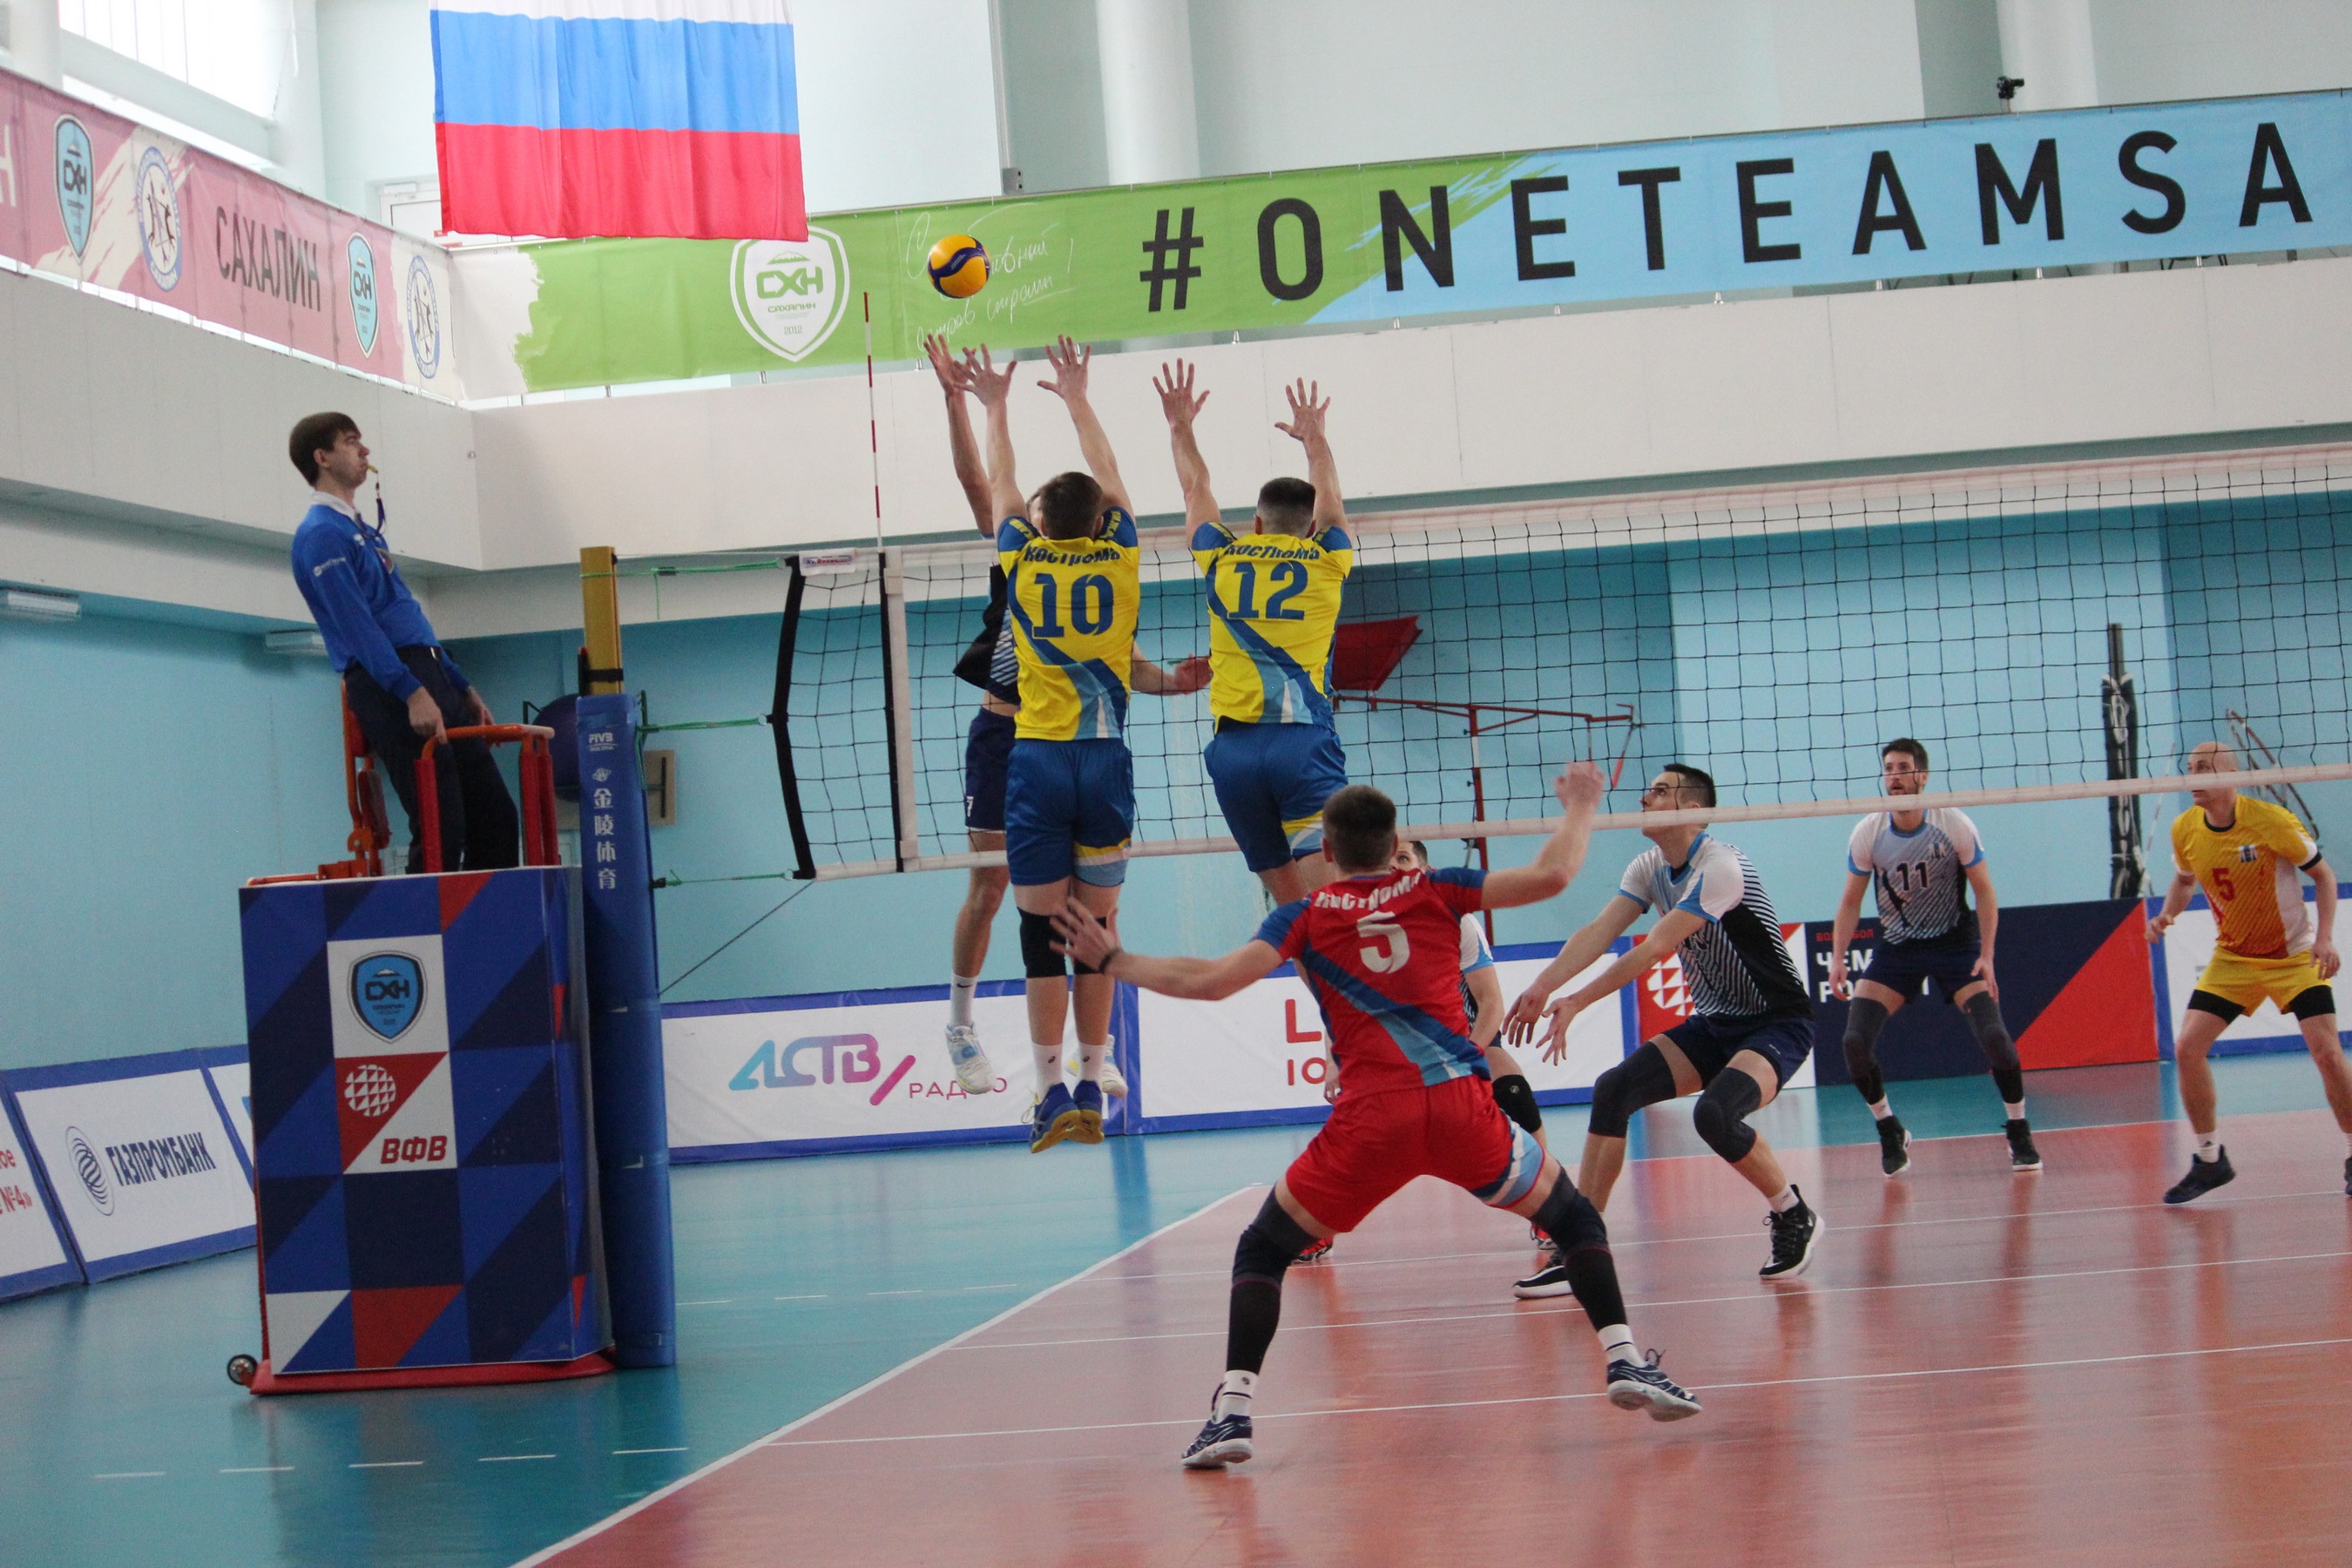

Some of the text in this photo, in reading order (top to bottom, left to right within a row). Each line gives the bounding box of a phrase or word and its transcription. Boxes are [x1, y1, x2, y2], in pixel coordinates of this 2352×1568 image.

[215, 205, 321, 312] САХАЛИН
[767, 302, 816, 314] САХАЛИН
[1032, 573, 1113, 639] 10
[1227, 560, 1308, 621] 12
[588, 732, 614, 744] FIVB
[593, 787, 617, 889] 金陵体育
[1896, 862, 1929, 891] 11
[2211, 868, 2235, 902] 5
[1356, 910, 1411, 974] 5
[728, 1032, 881, 1091] АСТВ
[909, 1077, 1007, 1100] РАДО
[105, 1132, 216, 1186] ГАЗПРОМБАНК
[380, 1134, 448, 1165] ВФВ
